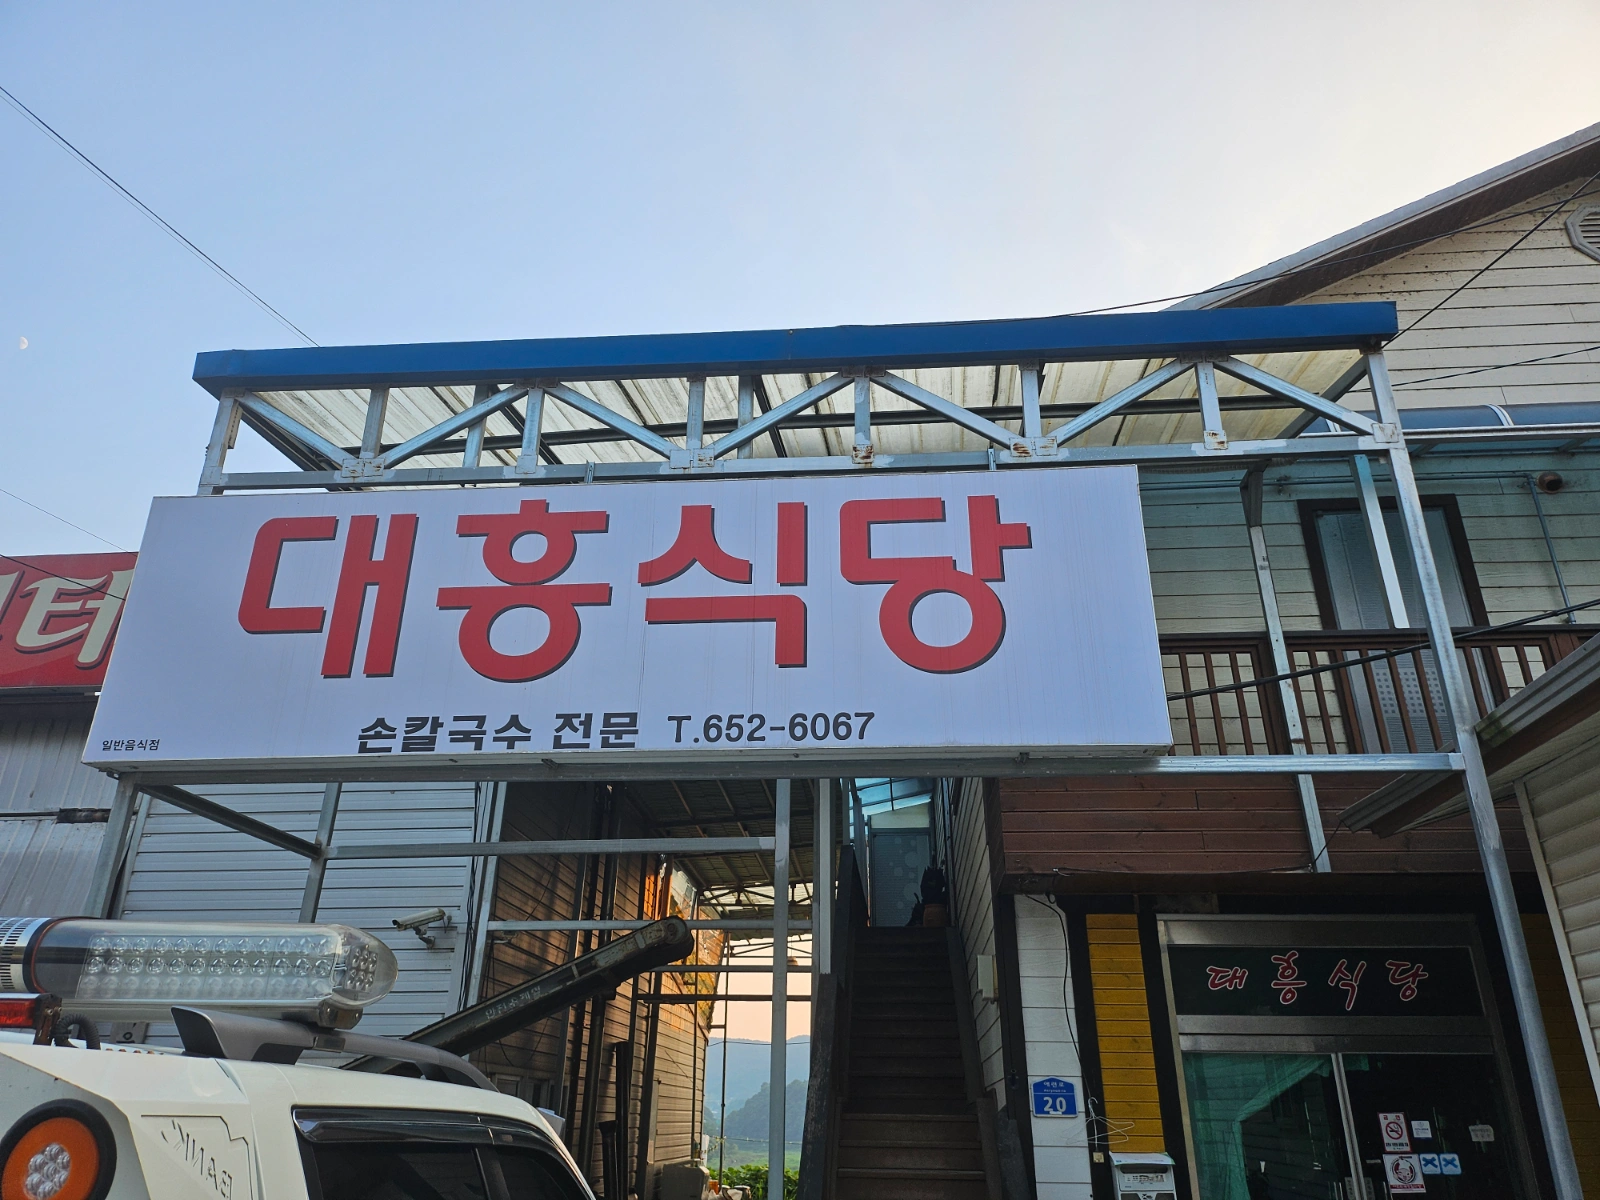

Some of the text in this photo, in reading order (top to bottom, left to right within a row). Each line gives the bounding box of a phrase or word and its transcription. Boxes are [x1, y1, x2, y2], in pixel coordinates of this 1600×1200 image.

[238, 495, 1031, 682] 대흥식당
[0, 568, 135, 663] 터
[102, 738, 160, 751] 일반음식점
[357, 711, 876, 754] 손칼국수 전문 T.652-6067
[1206, 950, 1429, 1011] 대흥식당
[1043, 1096, 1067, 1112] 20
